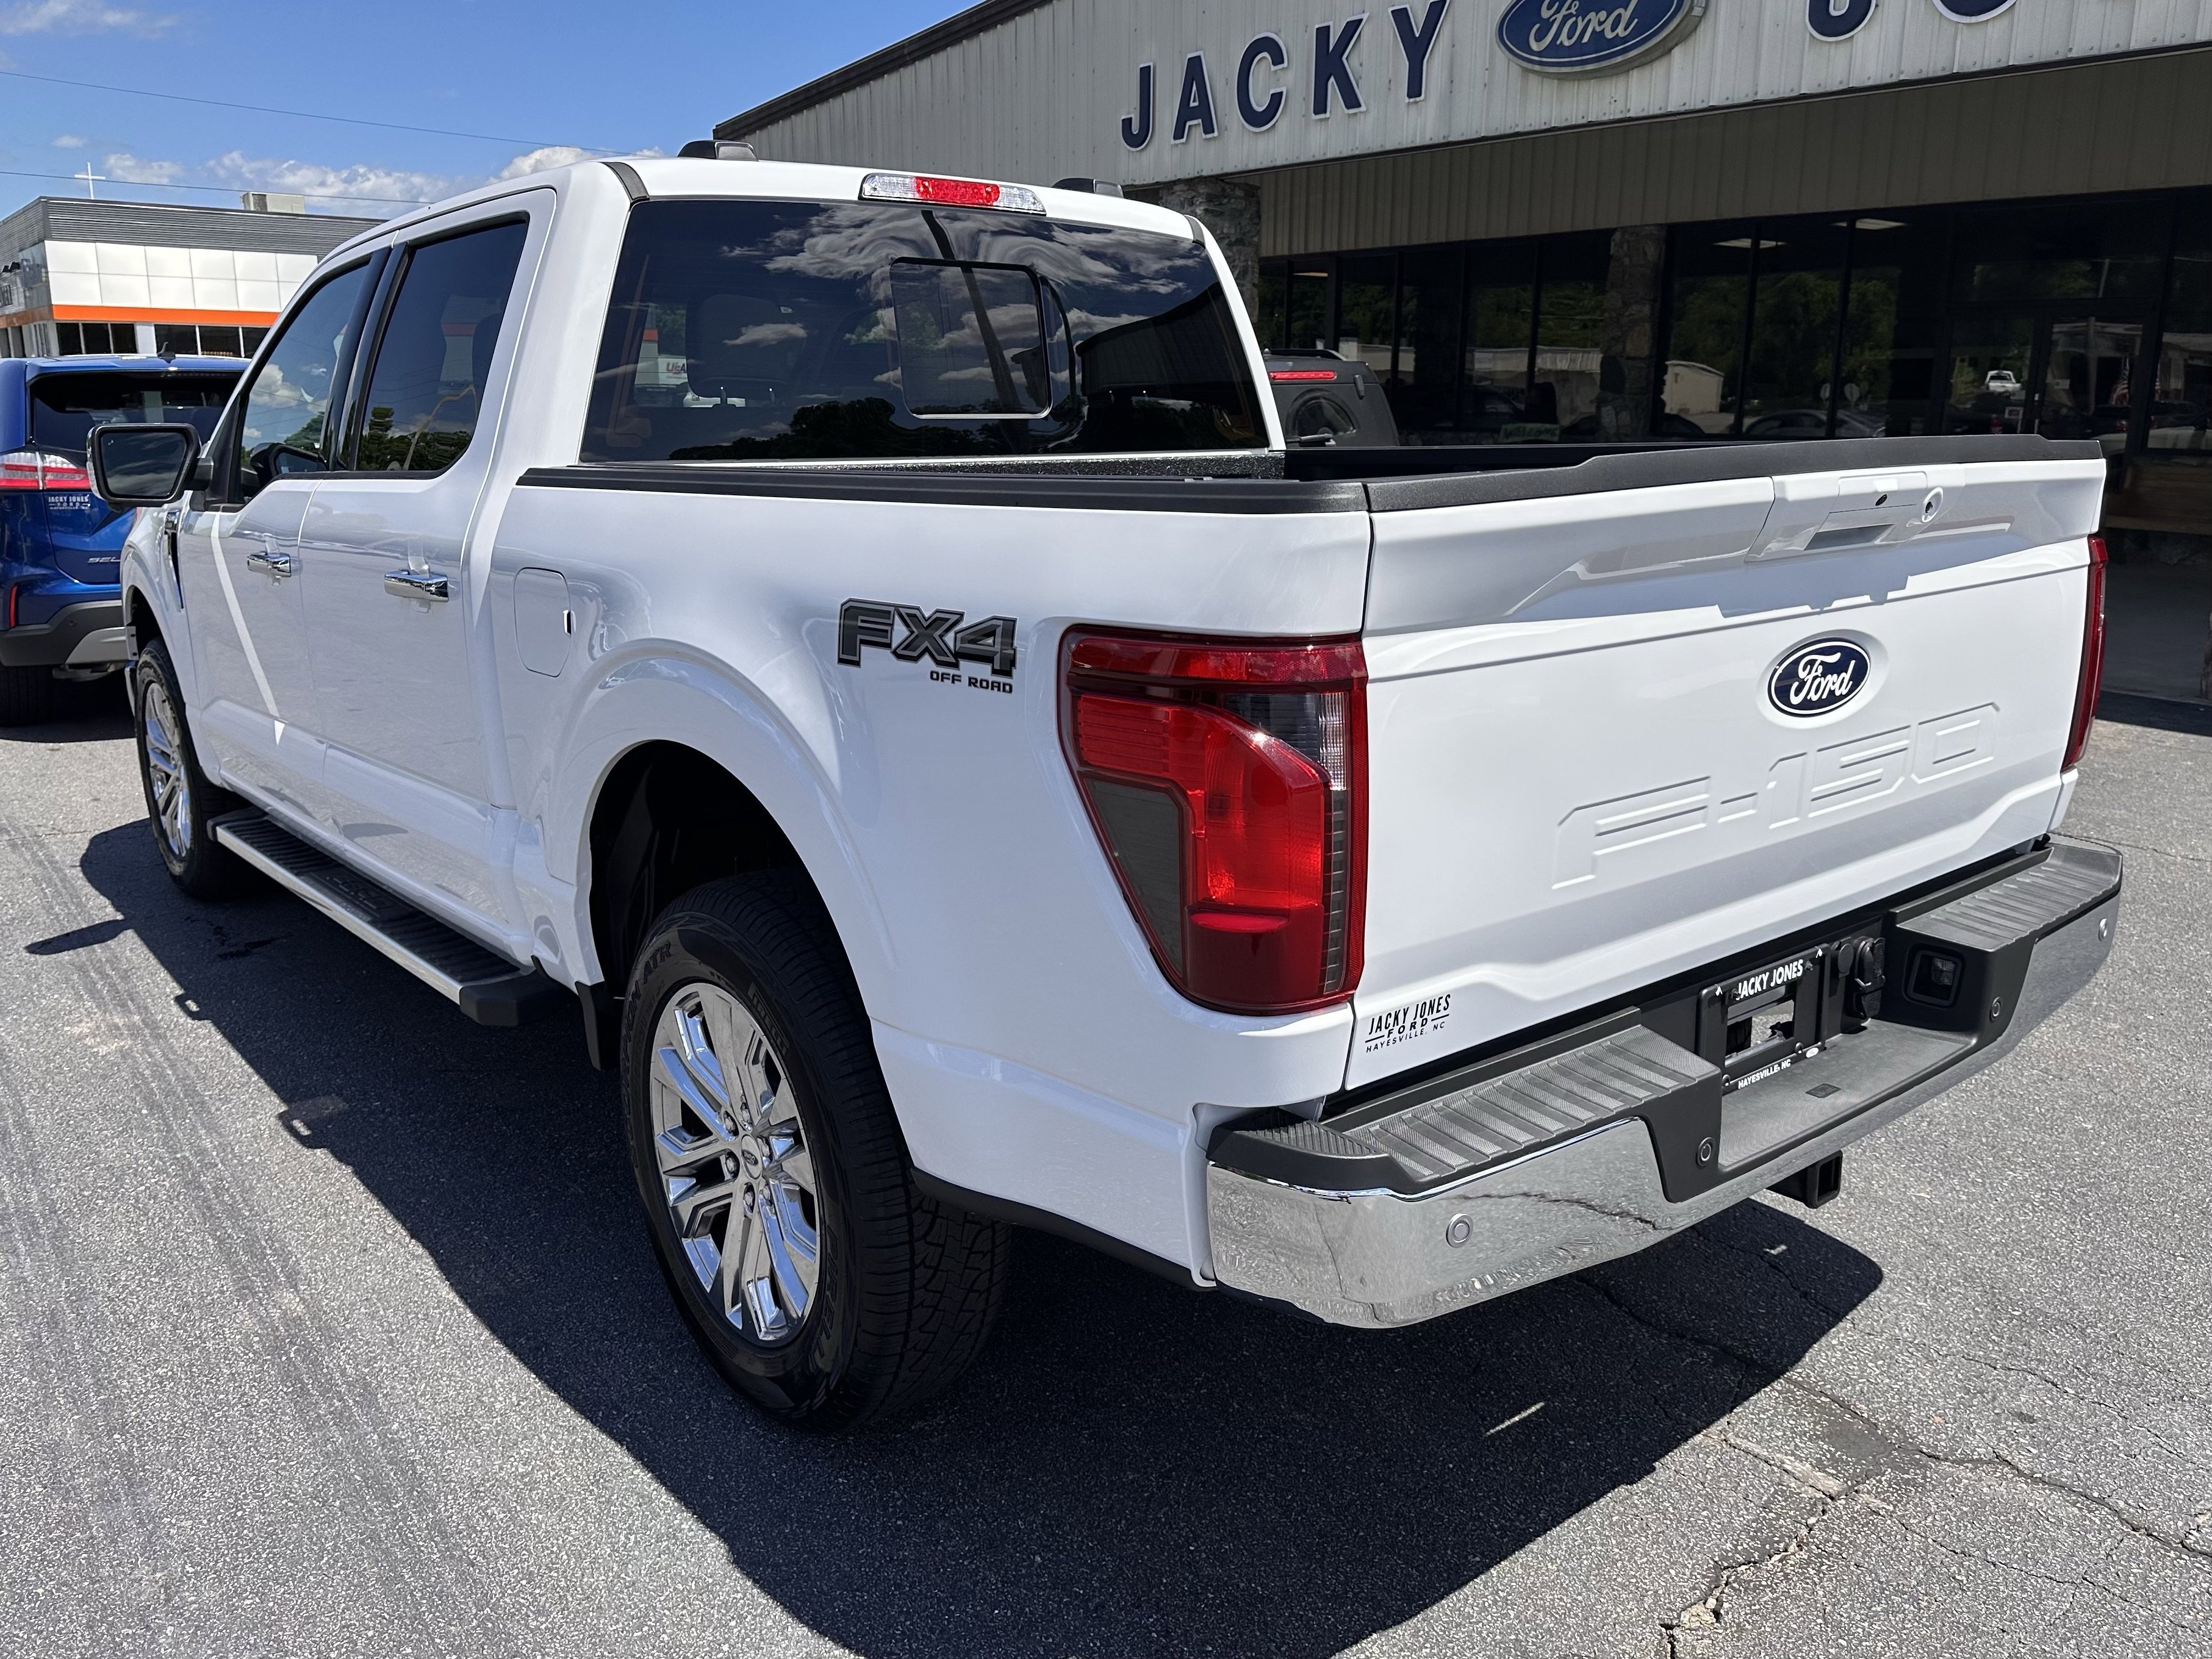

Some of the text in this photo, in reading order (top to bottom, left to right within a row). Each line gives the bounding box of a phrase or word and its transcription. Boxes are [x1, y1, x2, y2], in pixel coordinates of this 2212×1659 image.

[1528, 0, 1639, 52] Ford
[1121, 0, 1449, 152] JACKY
[837, 597, 1018, 679] FX4
[929, 670, 1013, 694] OFF ROAD
[1789, 651, 1855, 706] Ford
[1551, 702, 2000, 890] F-150
[643, 941, 672, 984] ATR
[1735, 959, 1803, 1001] JACKY JONES
[747, 981, 790, 1056] PIRELLI
[1368, 994, 1451, 1035] JACKY JONES
[1387, 1017, 1428, 1039] FORD
[1432, 1021, 1445, 1031] NC
[1737, 1058, 1791, 1089] HAYESVILLE, NC
